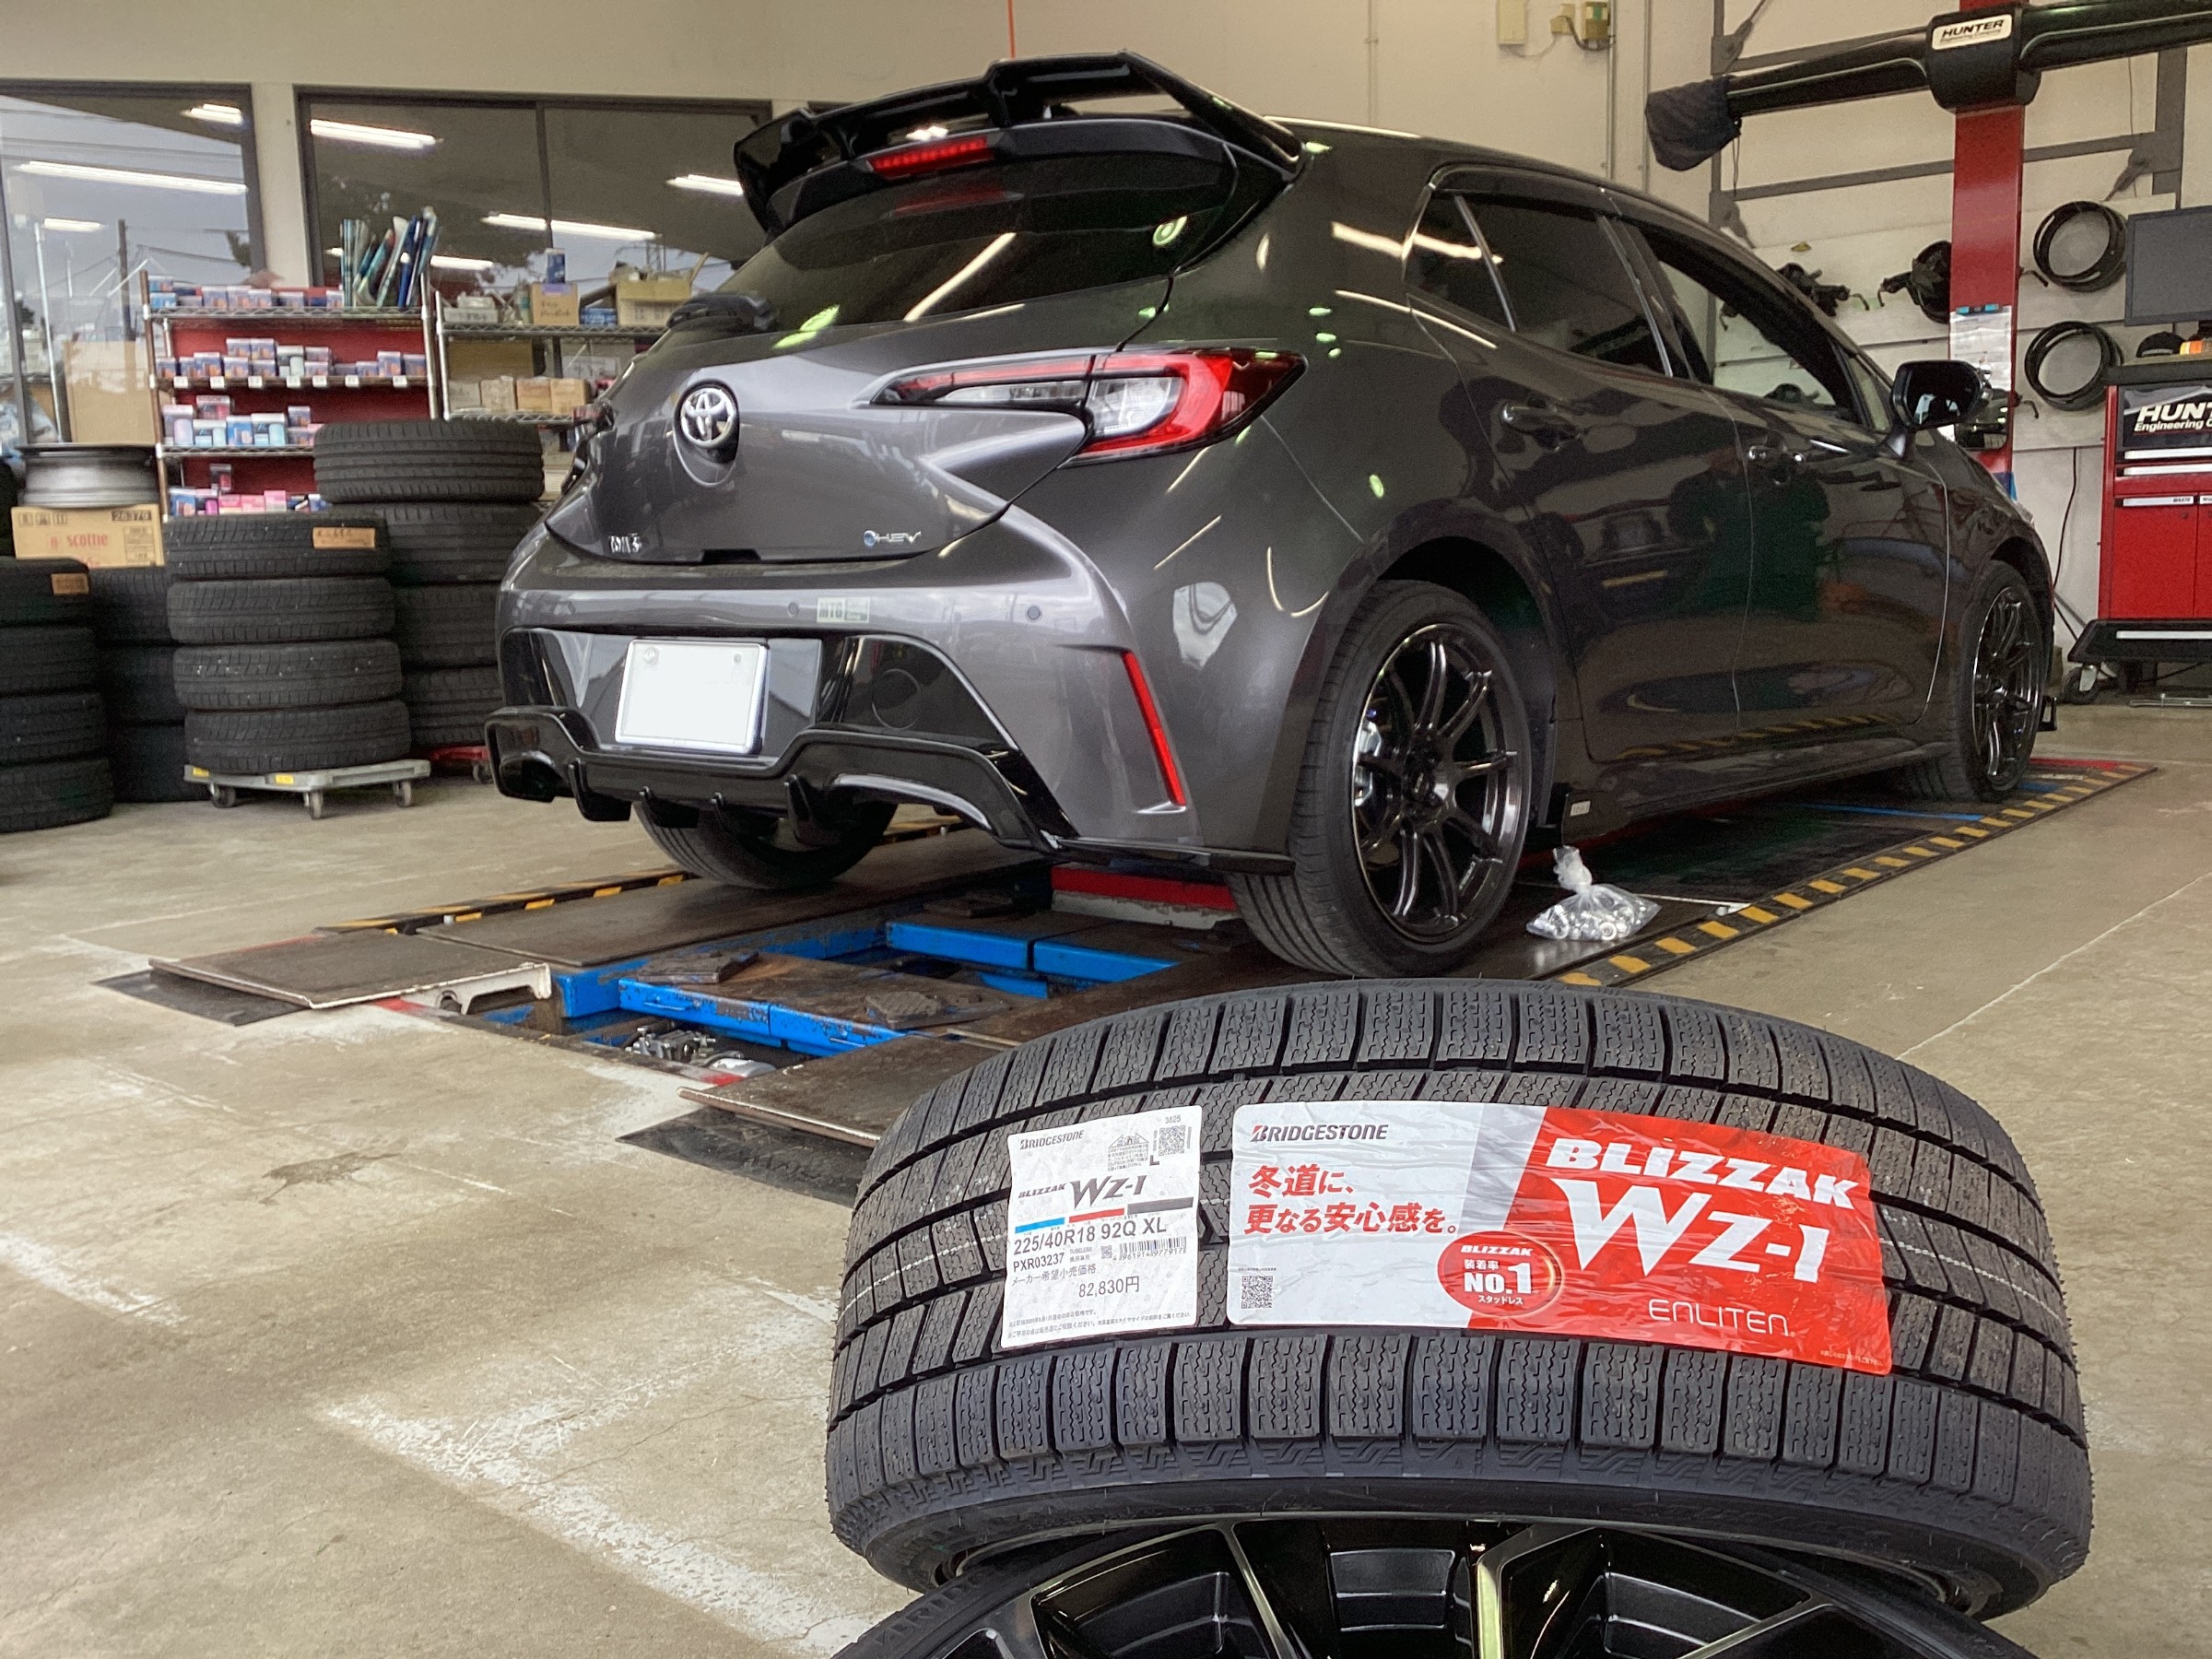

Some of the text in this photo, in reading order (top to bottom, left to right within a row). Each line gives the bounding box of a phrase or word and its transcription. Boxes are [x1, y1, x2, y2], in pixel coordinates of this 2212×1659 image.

[1942, 19, 2004, 38] HUNTER
[2134, 419, 2204, 432] Engineering
[1019, 1130, 1085, 1150] BRIDGESTONE
[1250, 1124, 1389, 1143] BRIDGESTONE
[1149, 1155, 1159, 1166] L
[1248, 1163, 1355, 1199] 冬道に、
[1545, 1137, 1859, 1210] BLIZZAK
[1018, 1182, 1066, 1199] BLIZZAK
[1244, 1201, 1456, 1235] 更なる安心感を。
[1013, 1225, 1096, 1255] 225/40R18
[1100, 1220, 1136, 1241] 92Q
[1142, 1217, 1167, 1234] XL
[1460, 1244, 1534, 1256] BLIZZAK
[1013, 1253, 1065, 1272] PXR03237
[1464, 1258, 1500, 1271] 装着率
[1011, 1263, 1097, 1287] メーカー希望小売価格
[1078, 1276, 1140, 1298] 82,830円
[1477, 1295, 1524, 1305] スタッドレス
[1648, 1298, 1789, 1337] ENLITEN
